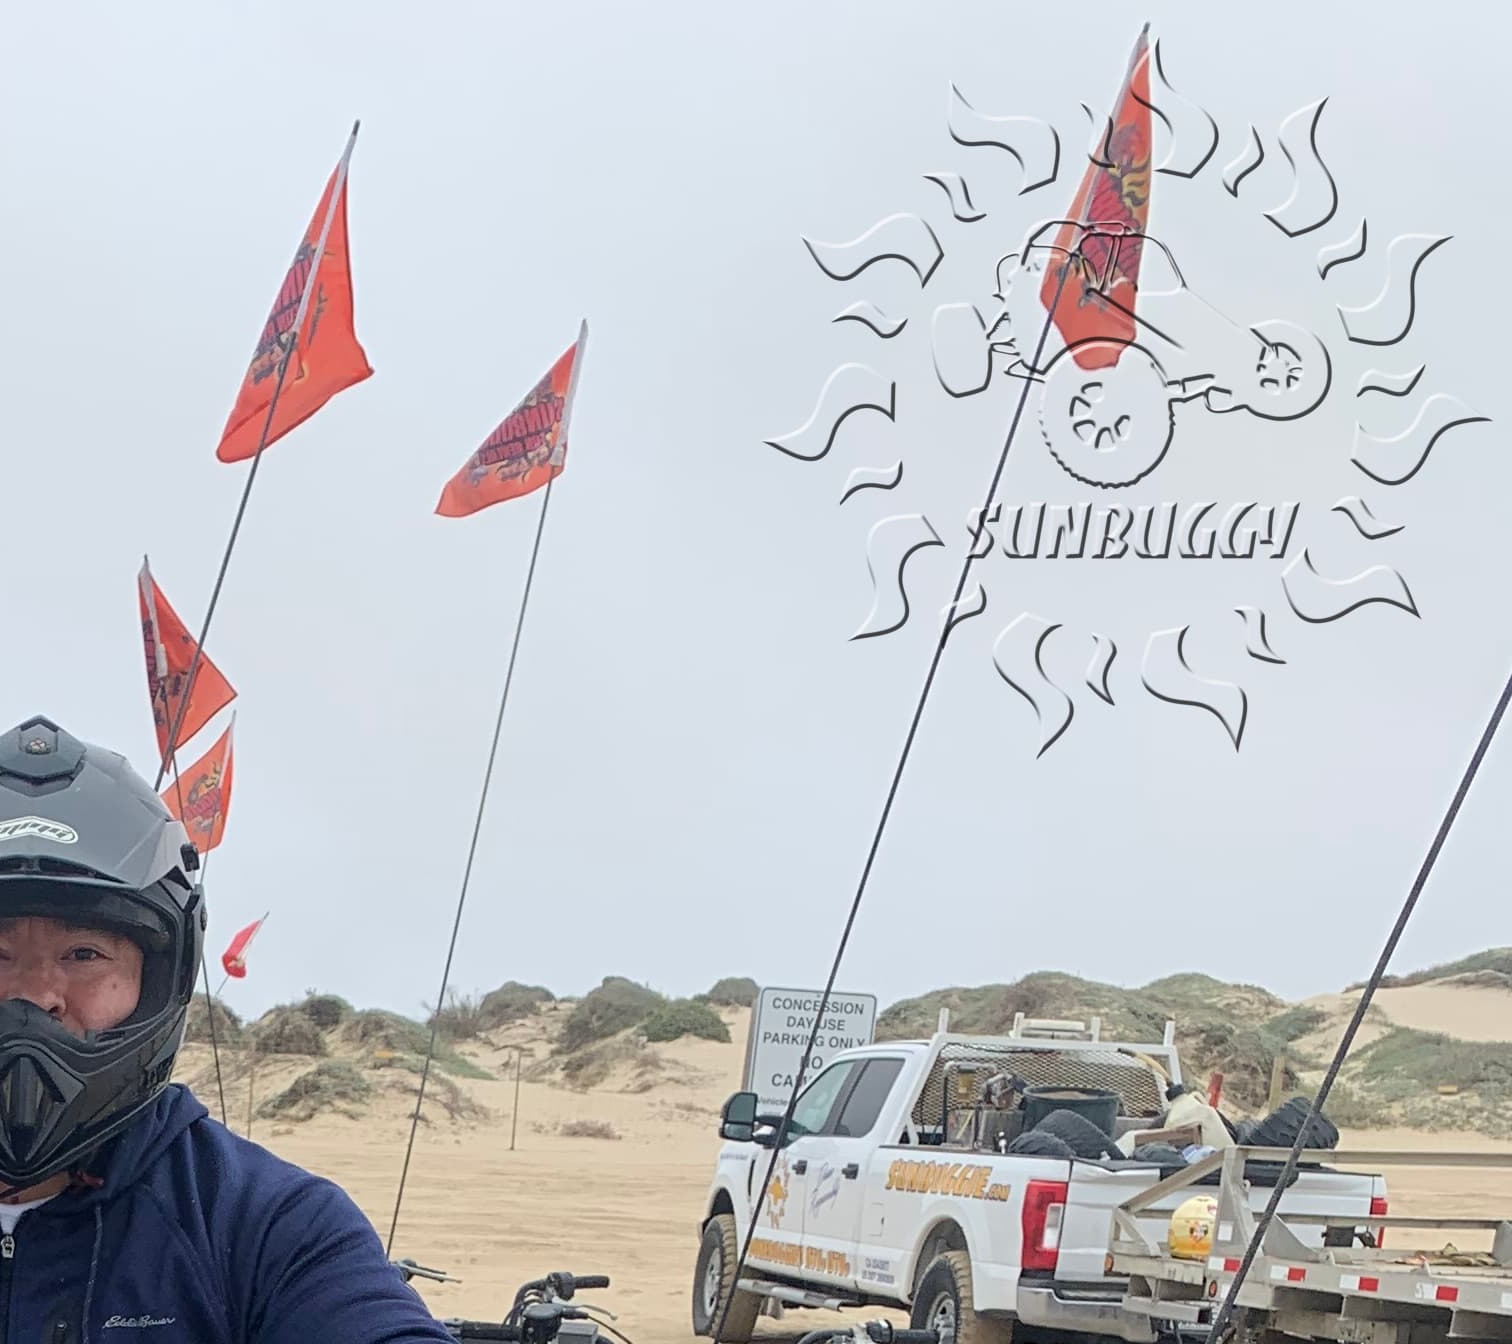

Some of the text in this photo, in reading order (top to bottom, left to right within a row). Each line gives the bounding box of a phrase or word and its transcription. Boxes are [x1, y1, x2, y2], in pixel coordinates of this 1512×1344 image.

[772, 997, 865, 1015] CONCESSION
[786, 1015, 846, 1031] DAY USE
[763, 1032, 865, 1049] PARKING ONLY
